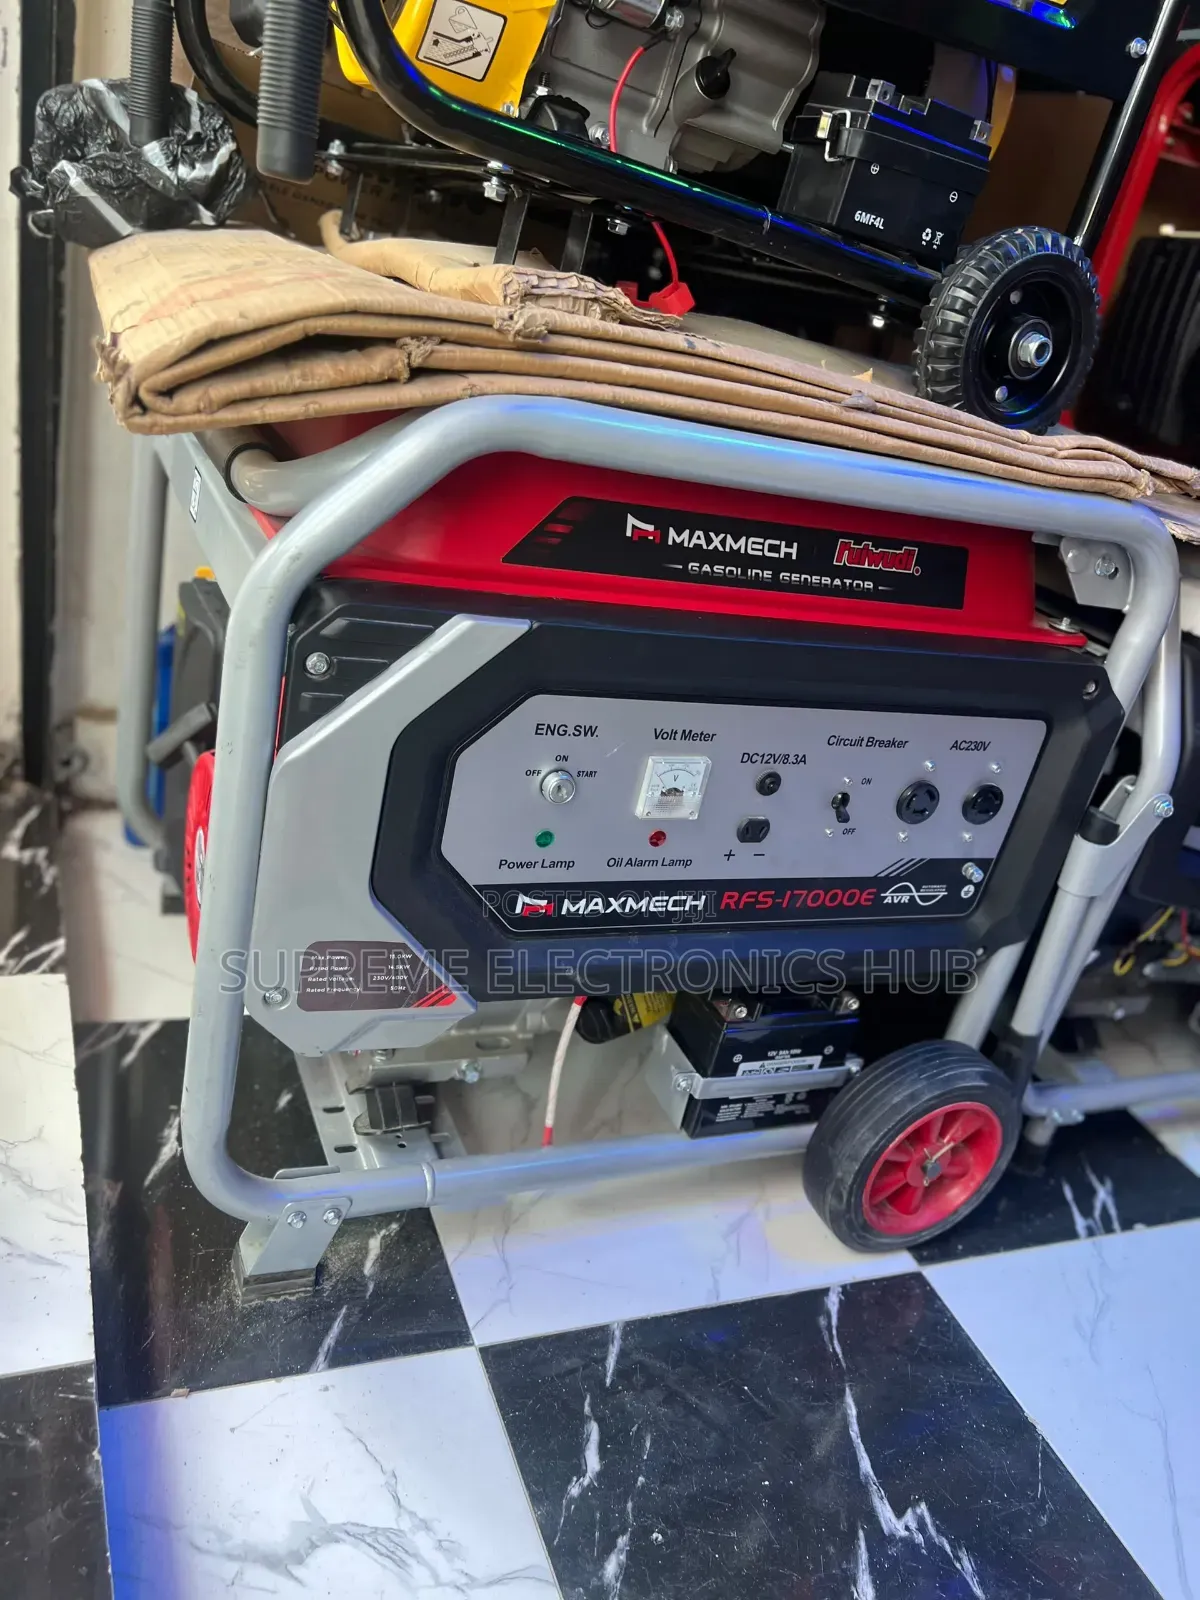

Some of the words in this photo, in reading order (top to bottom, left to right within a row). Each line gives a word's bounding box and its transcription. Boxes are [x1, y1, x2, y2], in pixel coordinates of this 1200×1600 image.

[854, 210, 885, 229] 6MF4L
[667, 526, 798, 560] MAXMECH
[687, 562, 773, 583] GASOLINE
[779, 572, 874, 593] GENERATOR
[534, 723, 599, 738] ENG.SW.
[653, 728, 678, 741] Volt
[679, 729, 717, 742] Meter
[827, 734, 865, 748] Circuit
[865, 736, 909, 750] Breaker
[949, 740, 991, 752] AC230V
[555, 754, 569, 762] ON
[740, 752, 807, 766] DC12V/8.3A
[525, 769, 542, 777] OFF
[576, 770, 598, 778] START
[860, 777, 872, 786] ON
[842, 827, 856, 835] OFF
[498, 859, 538, 870] Power
[540, 858, 575, 871] Lamp
[606, 857, 623, 868] Oil
[623, 857, 659, 868] Alarm
[660, 857, 693, 869] Lamp
[561, 894, 706, 915] MAXMECH
[719, 888, 877, 910] RFS-17000E
[883, 895, 911, 904] AVR
